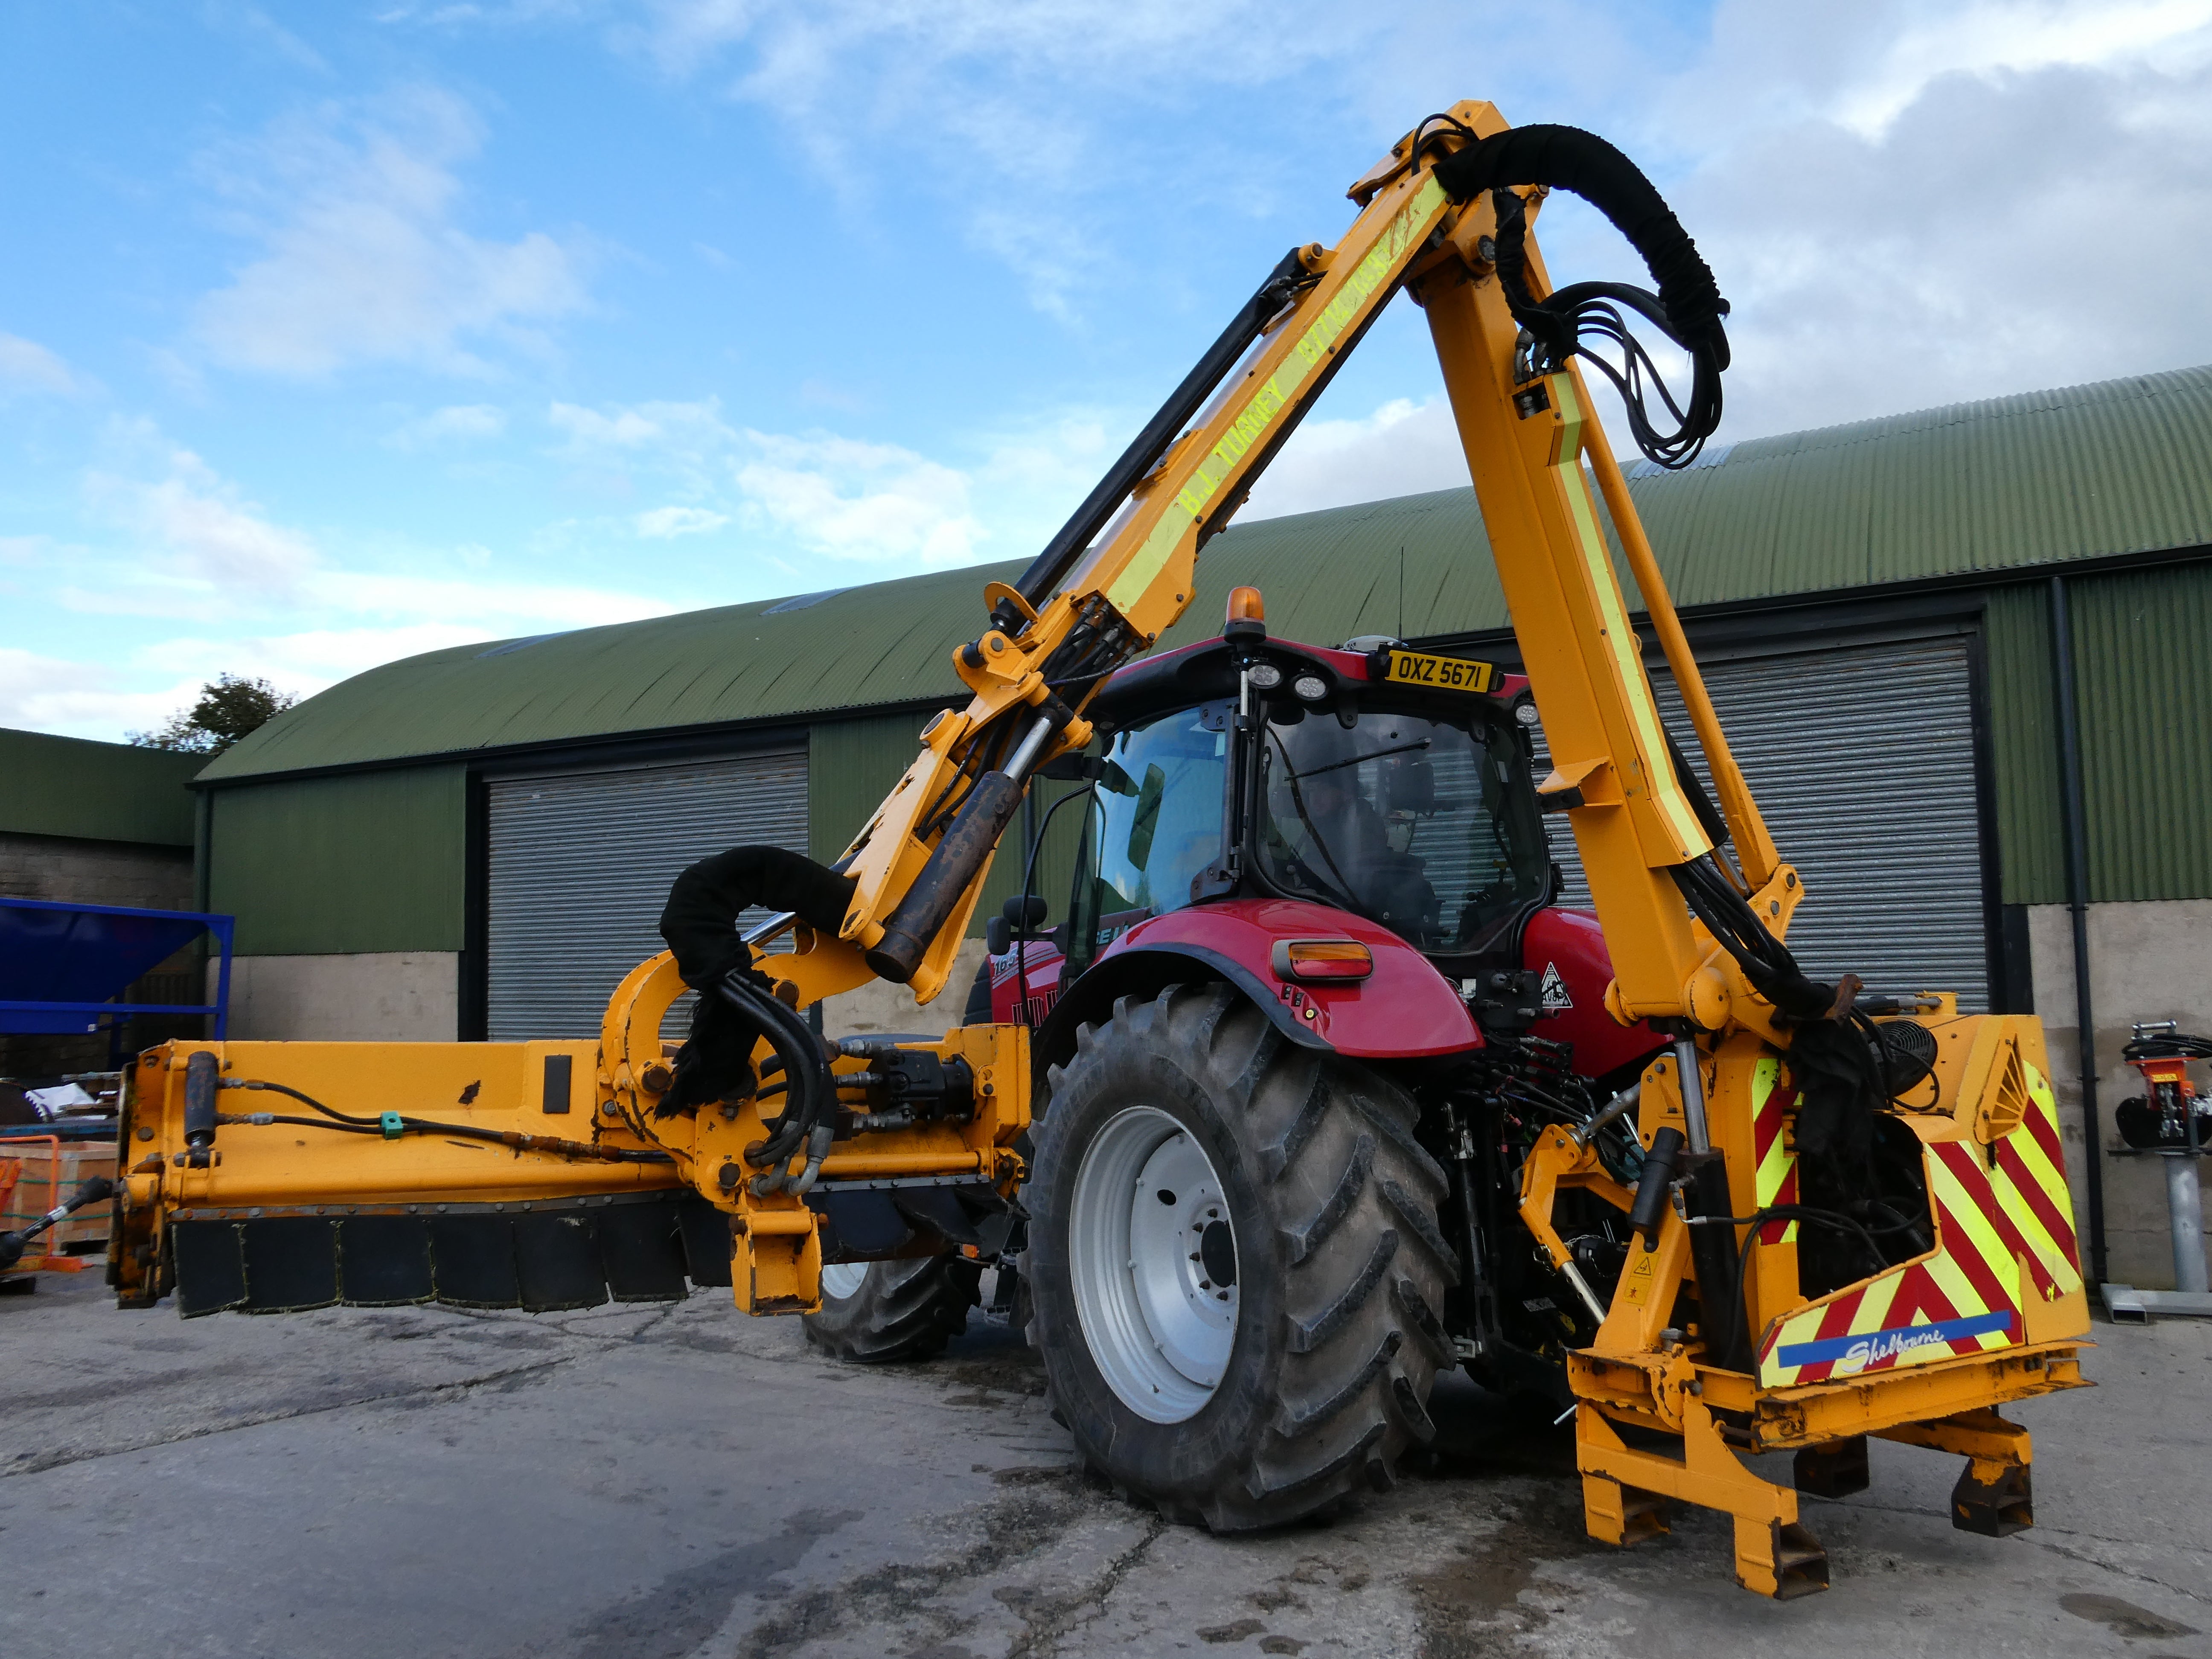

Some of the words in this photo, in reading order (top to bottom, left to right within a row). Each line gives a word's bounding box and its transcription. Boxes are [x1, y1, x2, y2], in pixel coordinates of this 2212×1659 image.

[1179, 469, 1221, 515] B.J.
[1212, 378, 1284, 466] TURNEY
[1398, 656, 1437, 682] OXZ
[1439, 661, 1482, 687] 5671
[1841, 1330, 1944, 1373] Shelbourne
